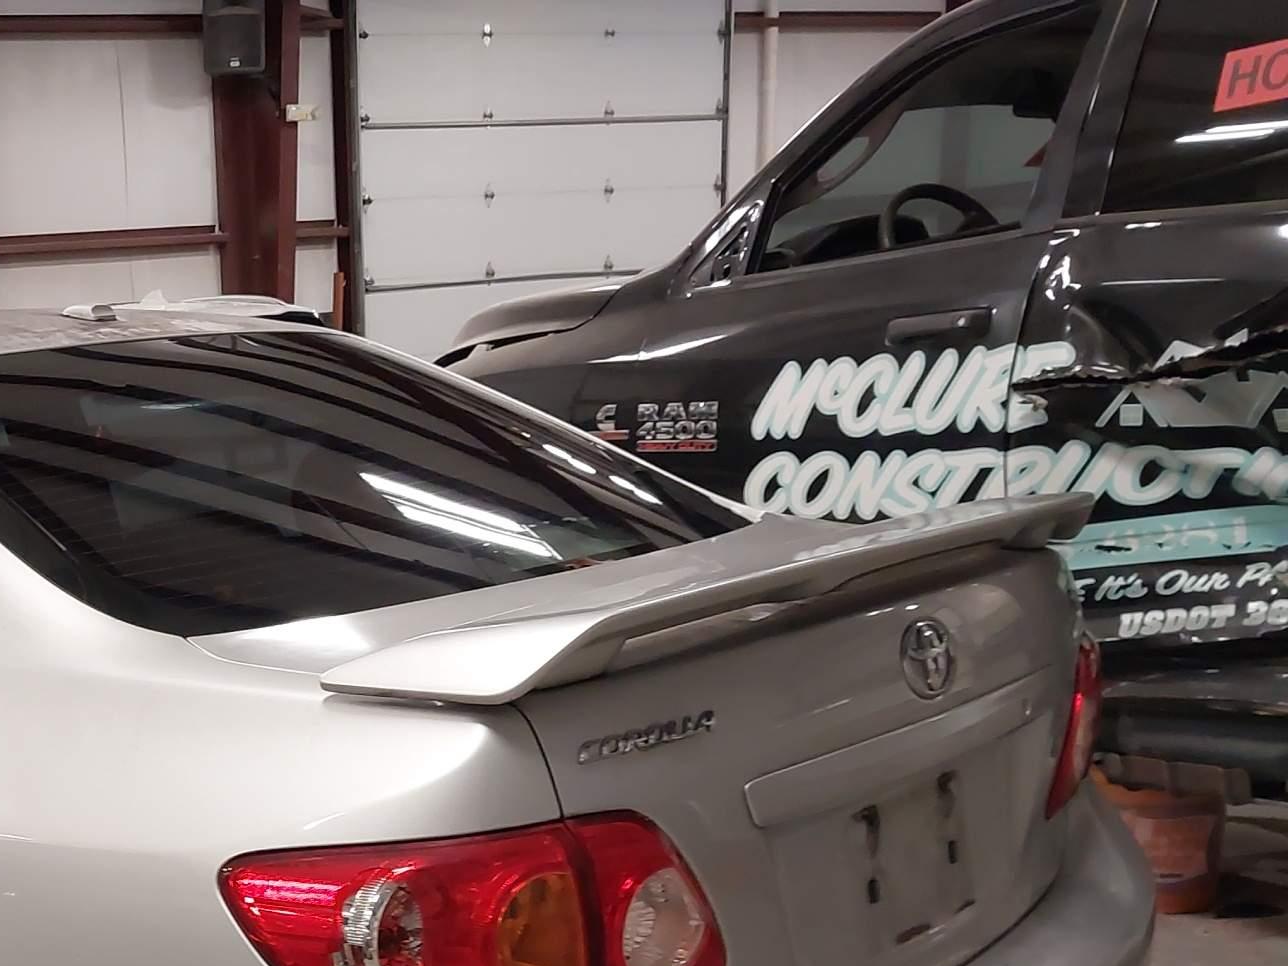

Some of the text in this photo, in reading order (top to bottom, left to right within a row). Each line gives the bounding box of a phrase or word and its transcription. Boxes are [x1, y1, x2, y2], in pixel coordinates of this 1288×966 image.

[637, 400, 719, 421] RAM
[635, 420, 718, 440] 4500
[1155, 569, 1231, 596] Our
[1118, 603, 1237, 638] USDOT
[577, 710, 716, 766] COROLLA
